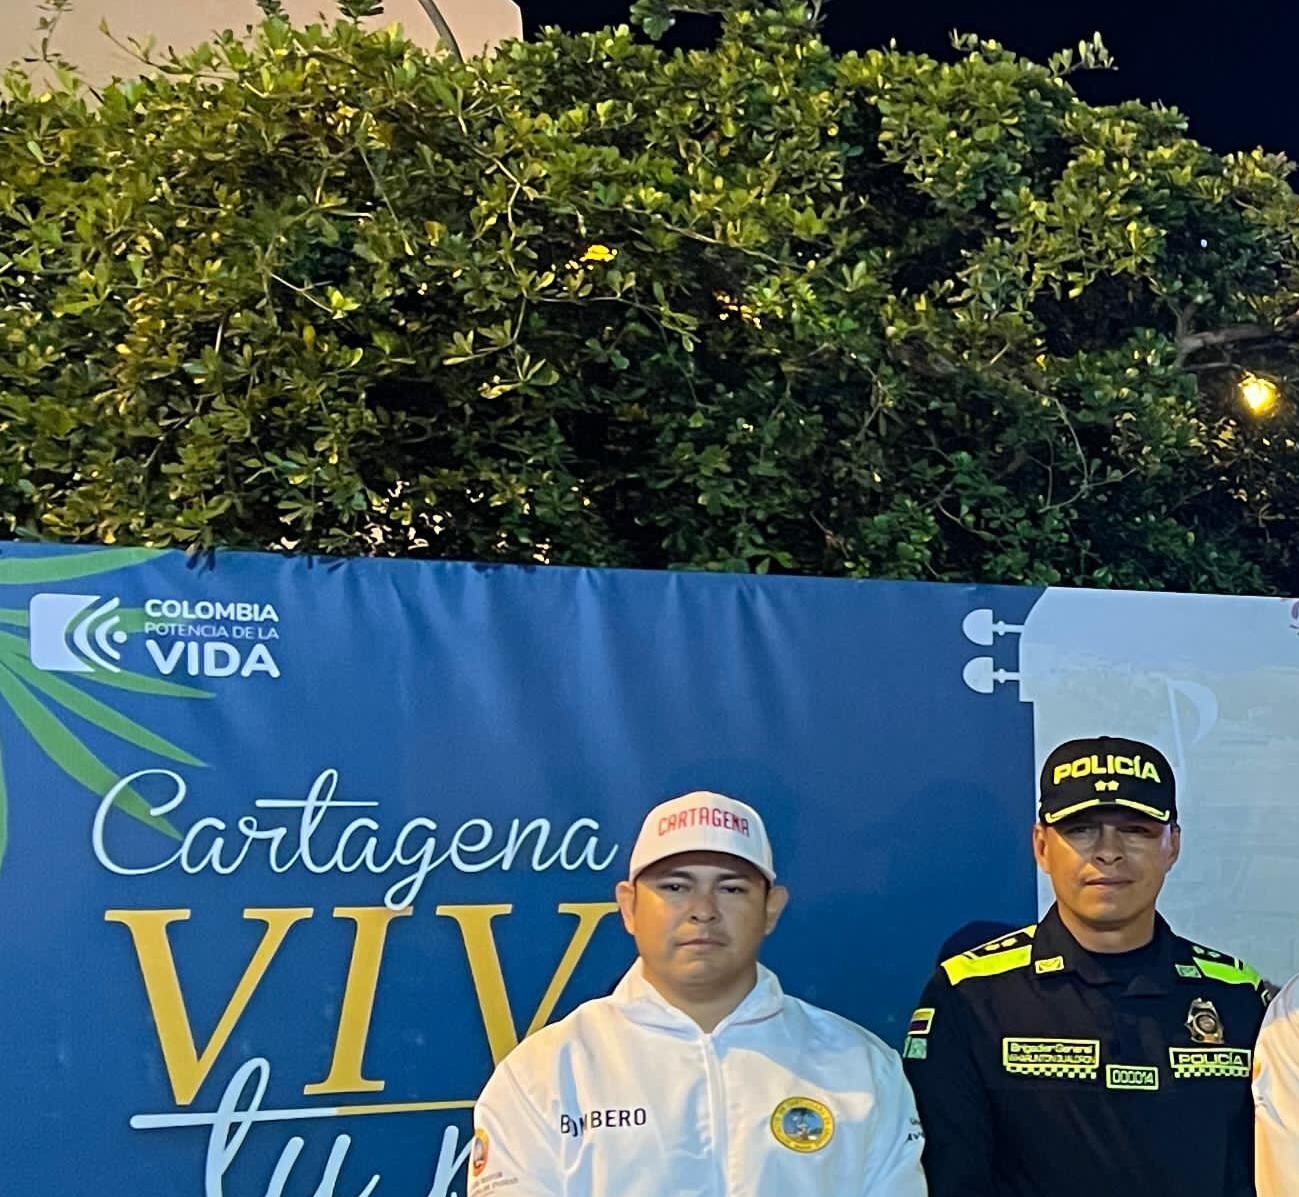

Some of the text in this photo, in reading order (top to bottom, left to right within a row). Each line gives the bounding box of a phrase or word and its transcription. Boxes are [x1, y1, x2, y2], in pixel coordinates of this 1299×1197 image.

[144, 599, 279, 622] COLOMBIA
[144, 622, 280, 640] POTENCIA DE LA
[144, 639, 281, 679] VIDA
[1053, 754, 1162, 785] POLICÍA
[657, 806, 750, 838] CARTAGENA
[92, 769, 619, 911] Cartagena
